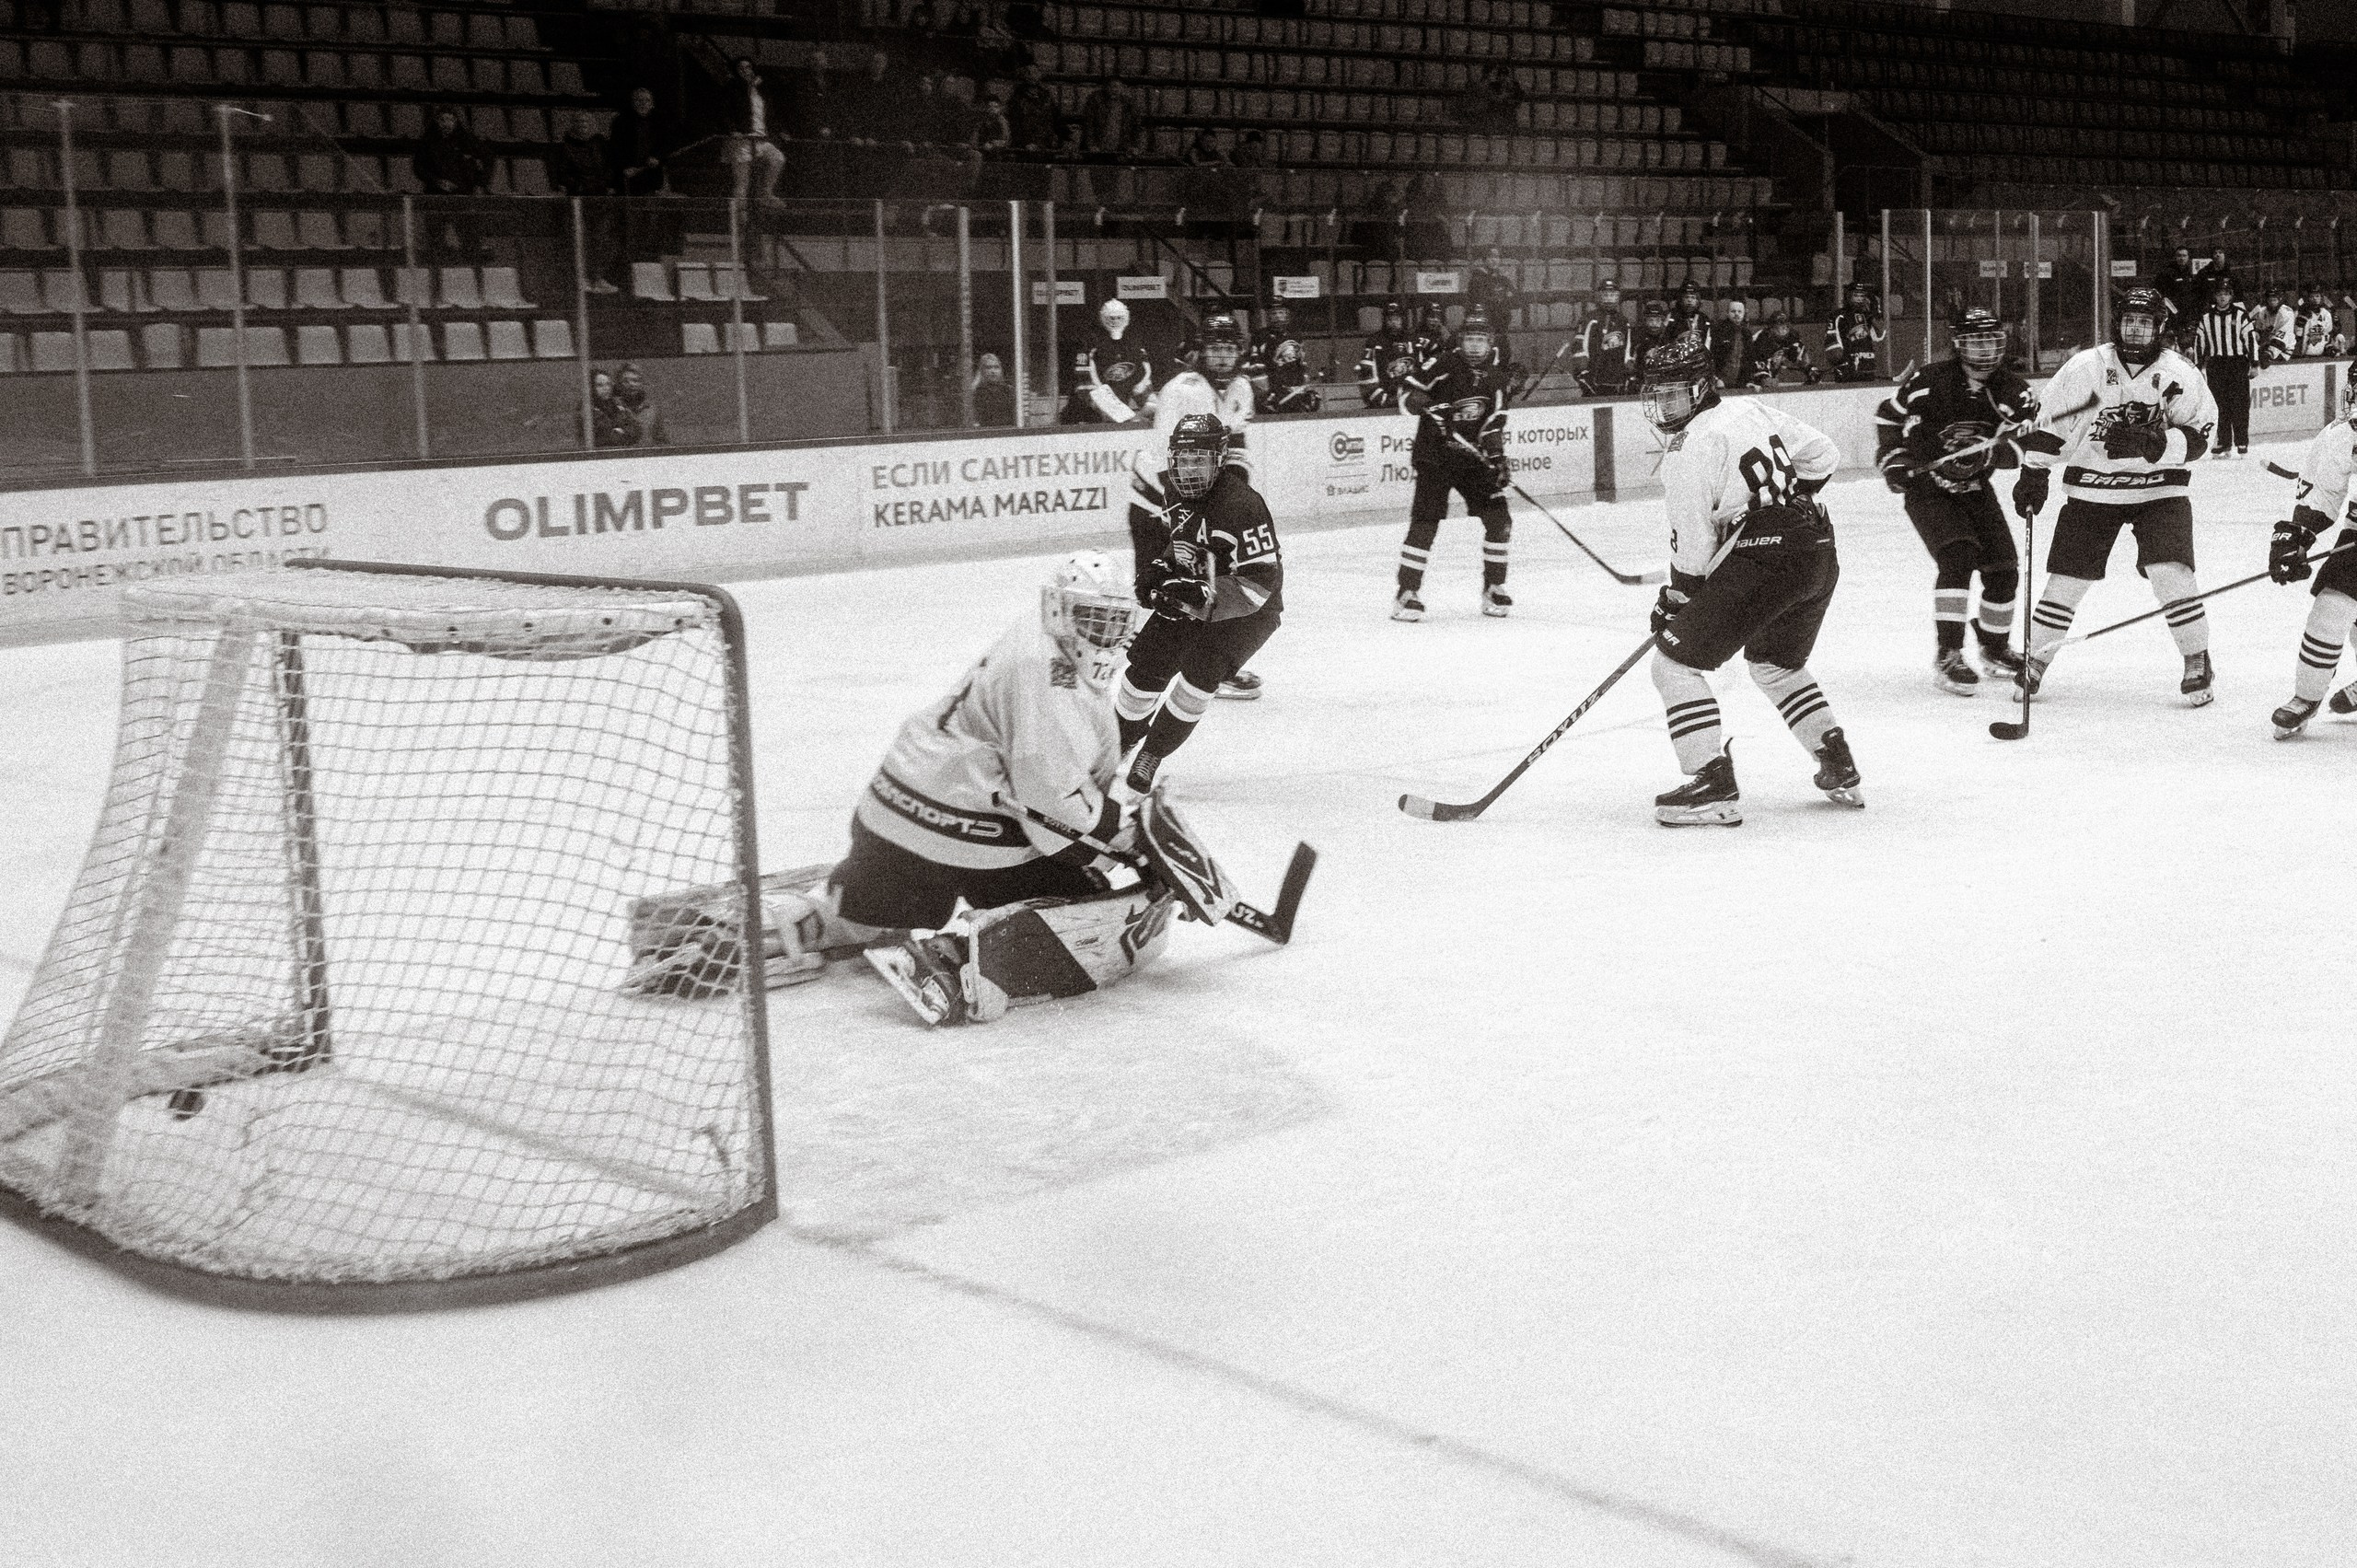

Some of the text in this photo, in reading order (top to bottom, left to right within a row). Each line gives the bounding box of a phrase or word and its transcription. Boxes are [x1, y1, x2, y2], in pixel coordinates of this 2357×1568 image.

[1517, 426, 1589, 446] которых
[874, 461, 950, 490] ЕСЛИ
[485, 482, 810, 541] OLIMPBET
[875, 486, 1108, 528] KERAMA MARAZZI
[2, 504, 328, 558] ПРАВИТЕЛЬСТВО
[1197, 518, 1209, 544] A
[1243, 523, 1274, 556] 55
